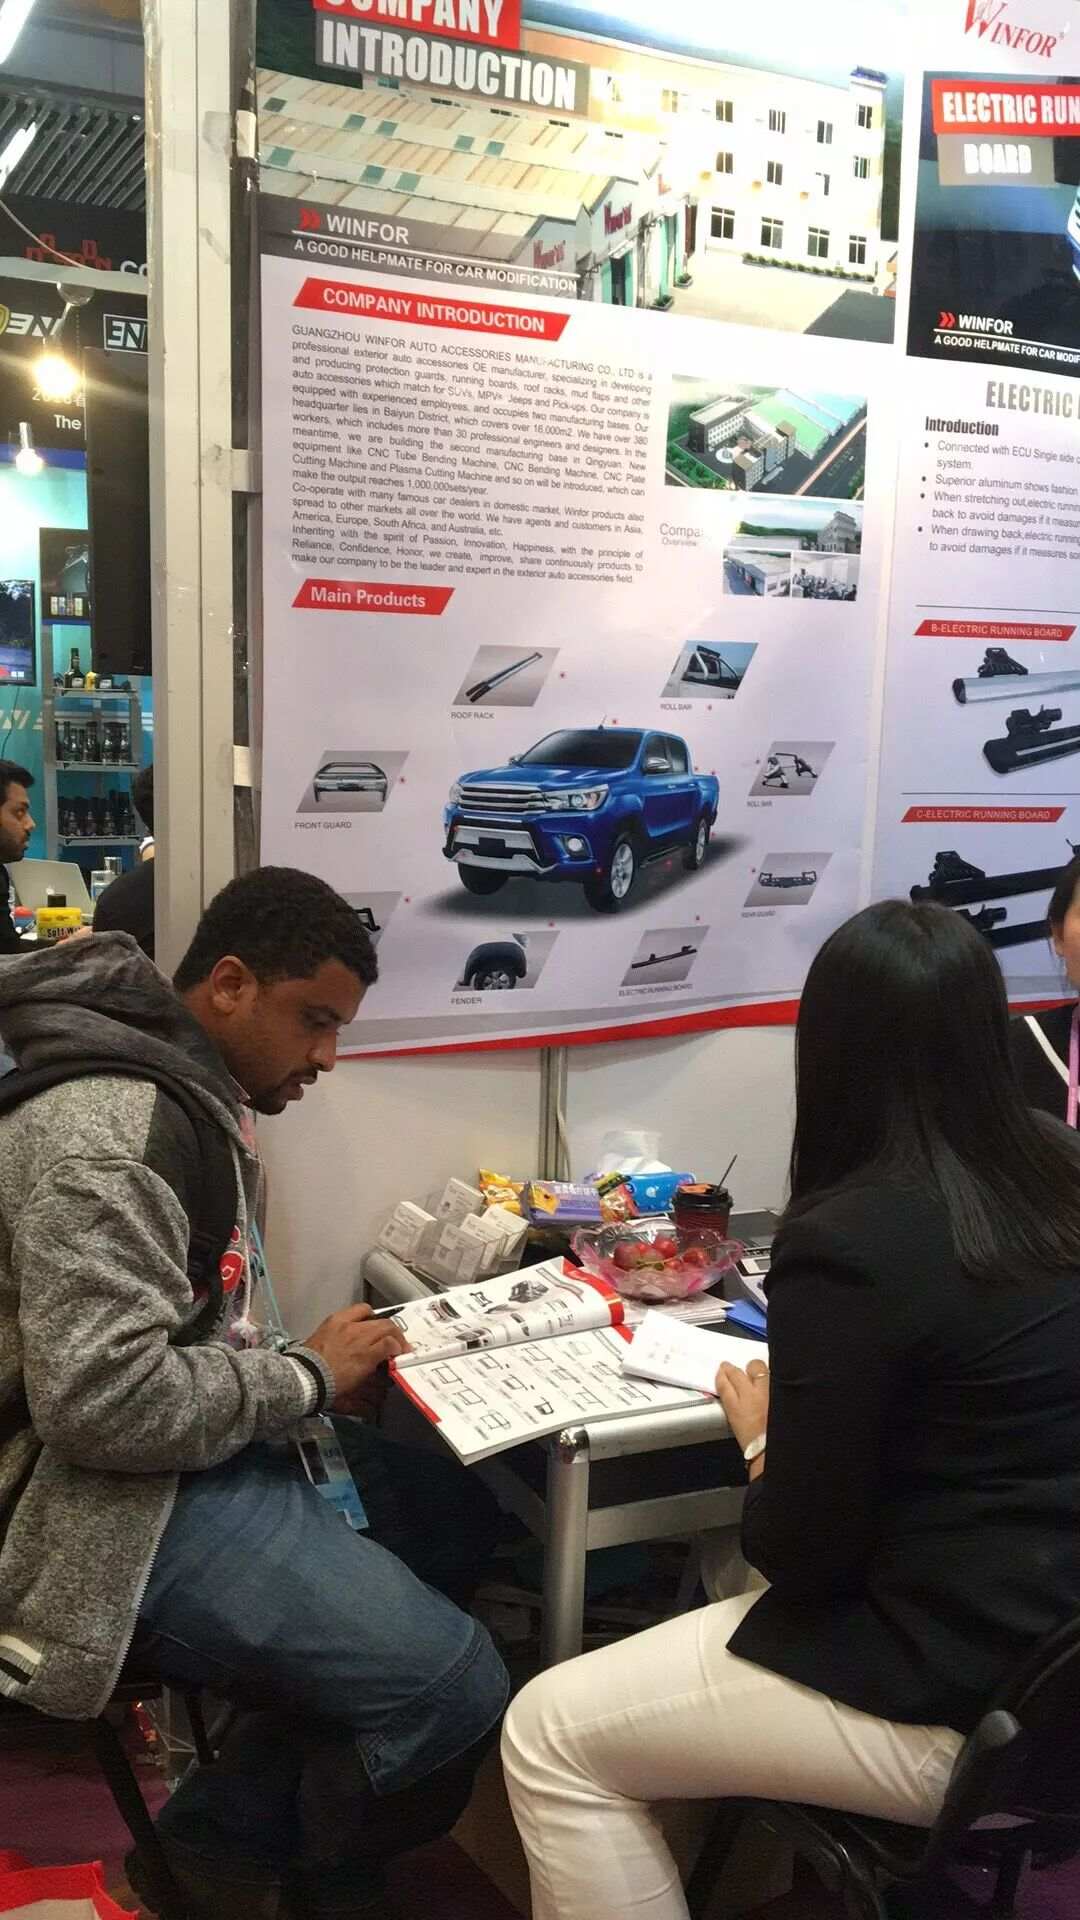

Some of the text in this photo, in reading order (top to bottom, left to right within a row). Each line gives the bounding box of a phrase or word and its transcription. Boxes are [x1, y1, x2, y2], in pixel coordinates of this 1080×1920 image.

[324, 0, 504, 38] PANY
[322, 20, 576, 111] INTRODUCTION
[942, 92, 1037, 124] ELECTRIC
[964, 143, 1032, 175] BOARD
[327, 213, 409, 245] WINFOR
[294, 239, 577, 292] A GOOD HELPMATE FOR CAR MODIFICATION
[322, 287, 545, 333] COMPANY INTRODUCTION
[958, 314, 1014, 335] WINFOR
[291, 325, 511, 362] GUANGZHOU WINFOR AUTO ACCESSORIES
[934, 335, 942, 345] A
[943, 336, 973, 348] GOOD
[973, 339, 1020, 354] HELPMATE
[1021, 345, 1038, 356] FOR
[1039, 348, 1056, 360] CAR
[291, 339, 651, 394] professional exterior auto accessories OE specializing developing
[314, 356, 651, 405] producing protection running roof other
[291, 382, 604, 428] equipped with experienced occupies manufacturing
[316, 370, 641, 419] accessories which match company
[985, 380, 1073, 419] ELECTRIC
[53, 414, 82, 430] The
[291, 396, 479, 425] headquarter Baiyun which
[335, 415, 562, 450] which includes than professional engineers
[925, 416, 999, 436] Introduction
[291, 439, 457, 466] equipment CNC Tube Bending
[388, 435, 543, 461] building second manufacturing
[937, 440, 990, 454] Connected
[992, 445, 1010, 456] with
[1012, 446, 1032, 458] ECU
[1033, 448, 1058, 462] Single
[291, 453, 549, 486] Cutting Machine Plasma will
[292, 467, 404, 486] make output reaches
[935, 474, 977, 487] Superior
[978, 477, 1022, 490] aluminum
[1024, 481, 1050, 493] shows
[291, 482, 625, 522] Co-operate with many famous domestic products
[934, 491, 963, 503] When
[966, 494, 1010, 507] stretching
[291, 496, 612, 531] spread markets We have agents customers
[373, 516, 399, 526] South
[932, 508, 955, 519] back
[957, 510, 967, 519] to
[969, 511, 995, 521] avoid
[997, 513, 1037, 526] damages
[292, 523, 631, 560] Inheriting principle
[931, 524, 959, 535] When
[961, 526, 999, 540] drawing
[929, 541, 938, 551] to
[940, 542, 966, 552] avoid
[969, 544, 1013, 557] damages
[336, 557, 614, 582] company leader expert accessories
[544, 556, 632, 573] continuously products
[311, 586, 426, 608] Main Products
[931, 623, 1062, 638] B-ELECTRIC RUNNING BOARD
[451, 711, 494, 720] ROOF RACK
[323, 821, 352, 829] GUARD
[916, 809, 1050, 820] C-ELECTRIC RUNNING BOARD
[451, 997, 482, 1005] FENDER
